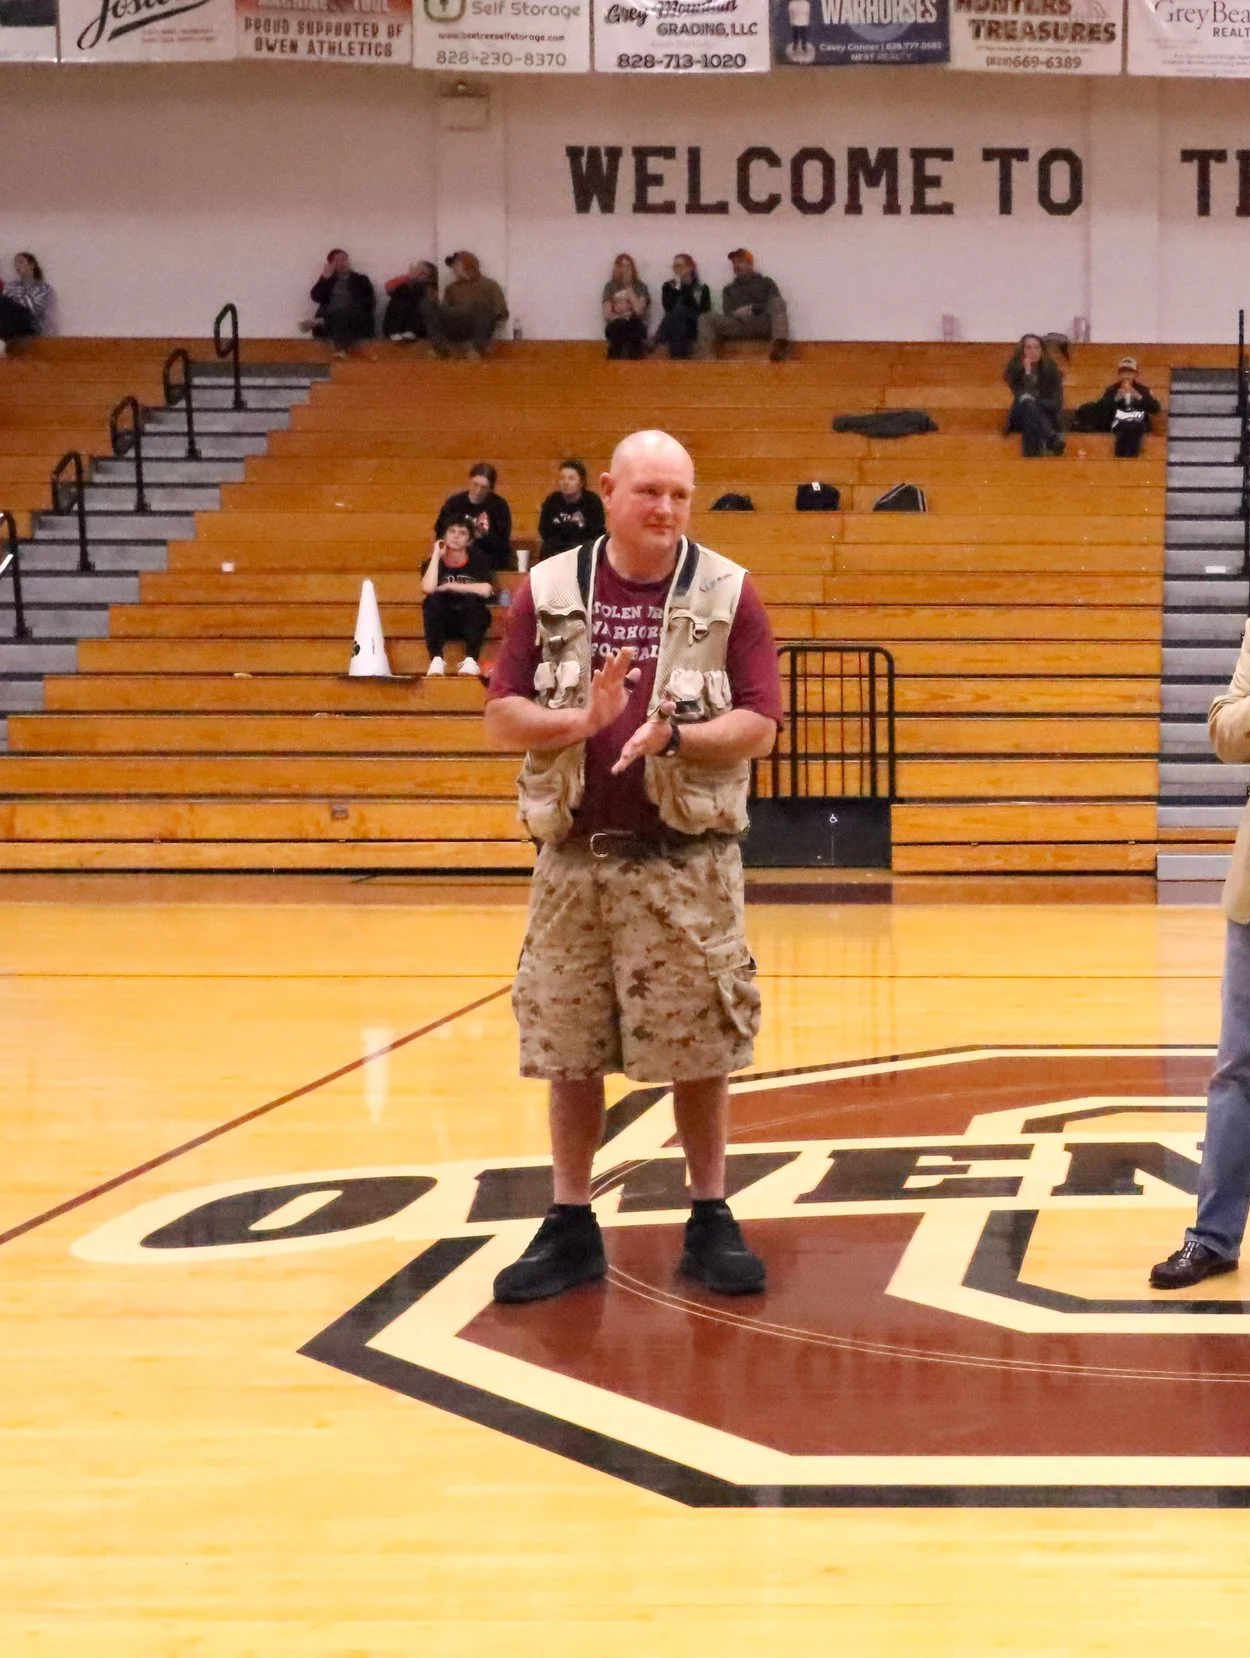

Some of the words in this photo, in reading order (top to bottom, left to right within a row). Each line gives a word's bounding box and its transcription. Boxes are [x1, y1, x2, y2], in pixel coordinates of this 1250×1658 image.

[472, 1, 505, 16] Self
[511, 2, 581, 20] Storage
[820, 0, 938, 24] WARHORSES
[244, 17, 290, 34] PROUD
[297, 20, 379, 38] SUPPORTER
[387, 23, 404, 39] OF
[968, 19, 1117, 43] TREASURES
[254, 36, 299, 54] OWEN
[307, 39, 393, 58] ATHLETICS
[436, 51, 567, 67] 828-230-8370
[617, 53, 747, 69] 828-713-1020
[566, 146, 954, 215] WELCOME
[982, 147, 1084, 216] TO
[591, 601, 643, 620] TOLEN
